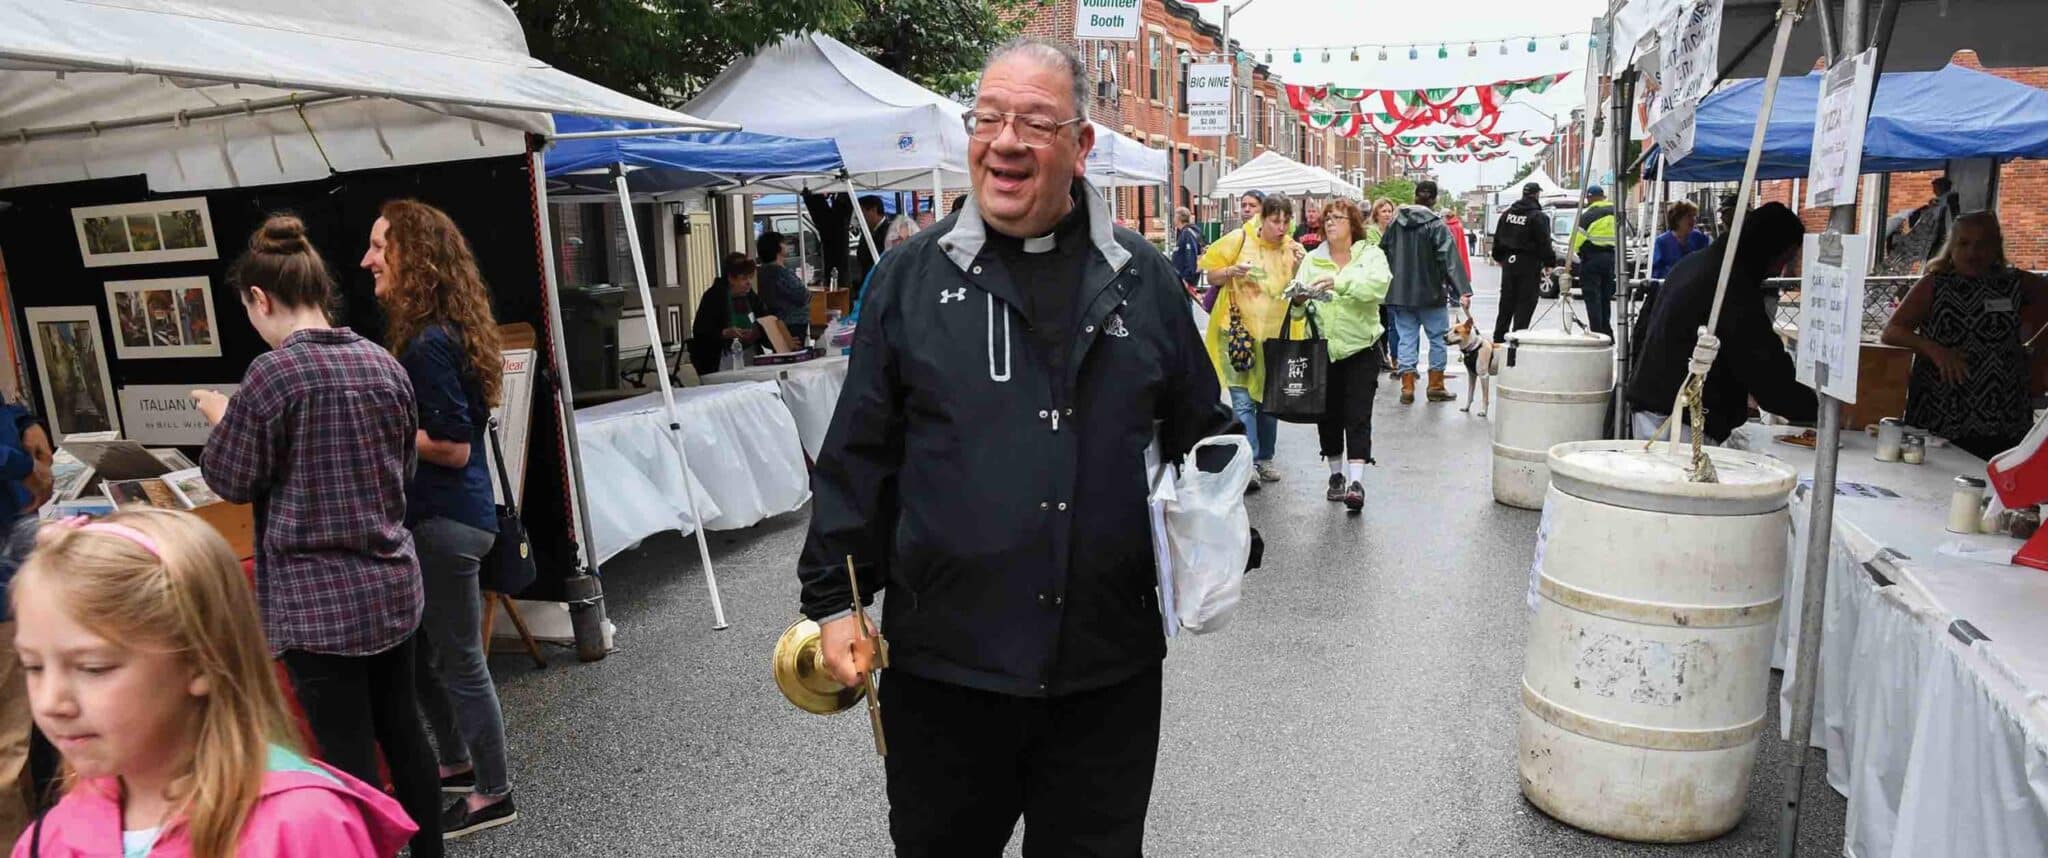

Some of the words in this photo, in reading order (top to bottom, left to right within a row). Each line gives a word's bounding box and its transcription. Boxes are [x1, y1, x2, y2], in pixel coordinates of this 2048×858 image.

[1083, 0, 1137, 8] Volunteer
[1090, 14, 1125, 28] Booth
[1190, 76, 1206, 88] BIG
[1208, 76, 1230, 88] NINE
[1506, 214, 1527, 225] POLICE
[140, 399, 186, 411] ITALIAN
[156, 420, 179, 429] BILL
